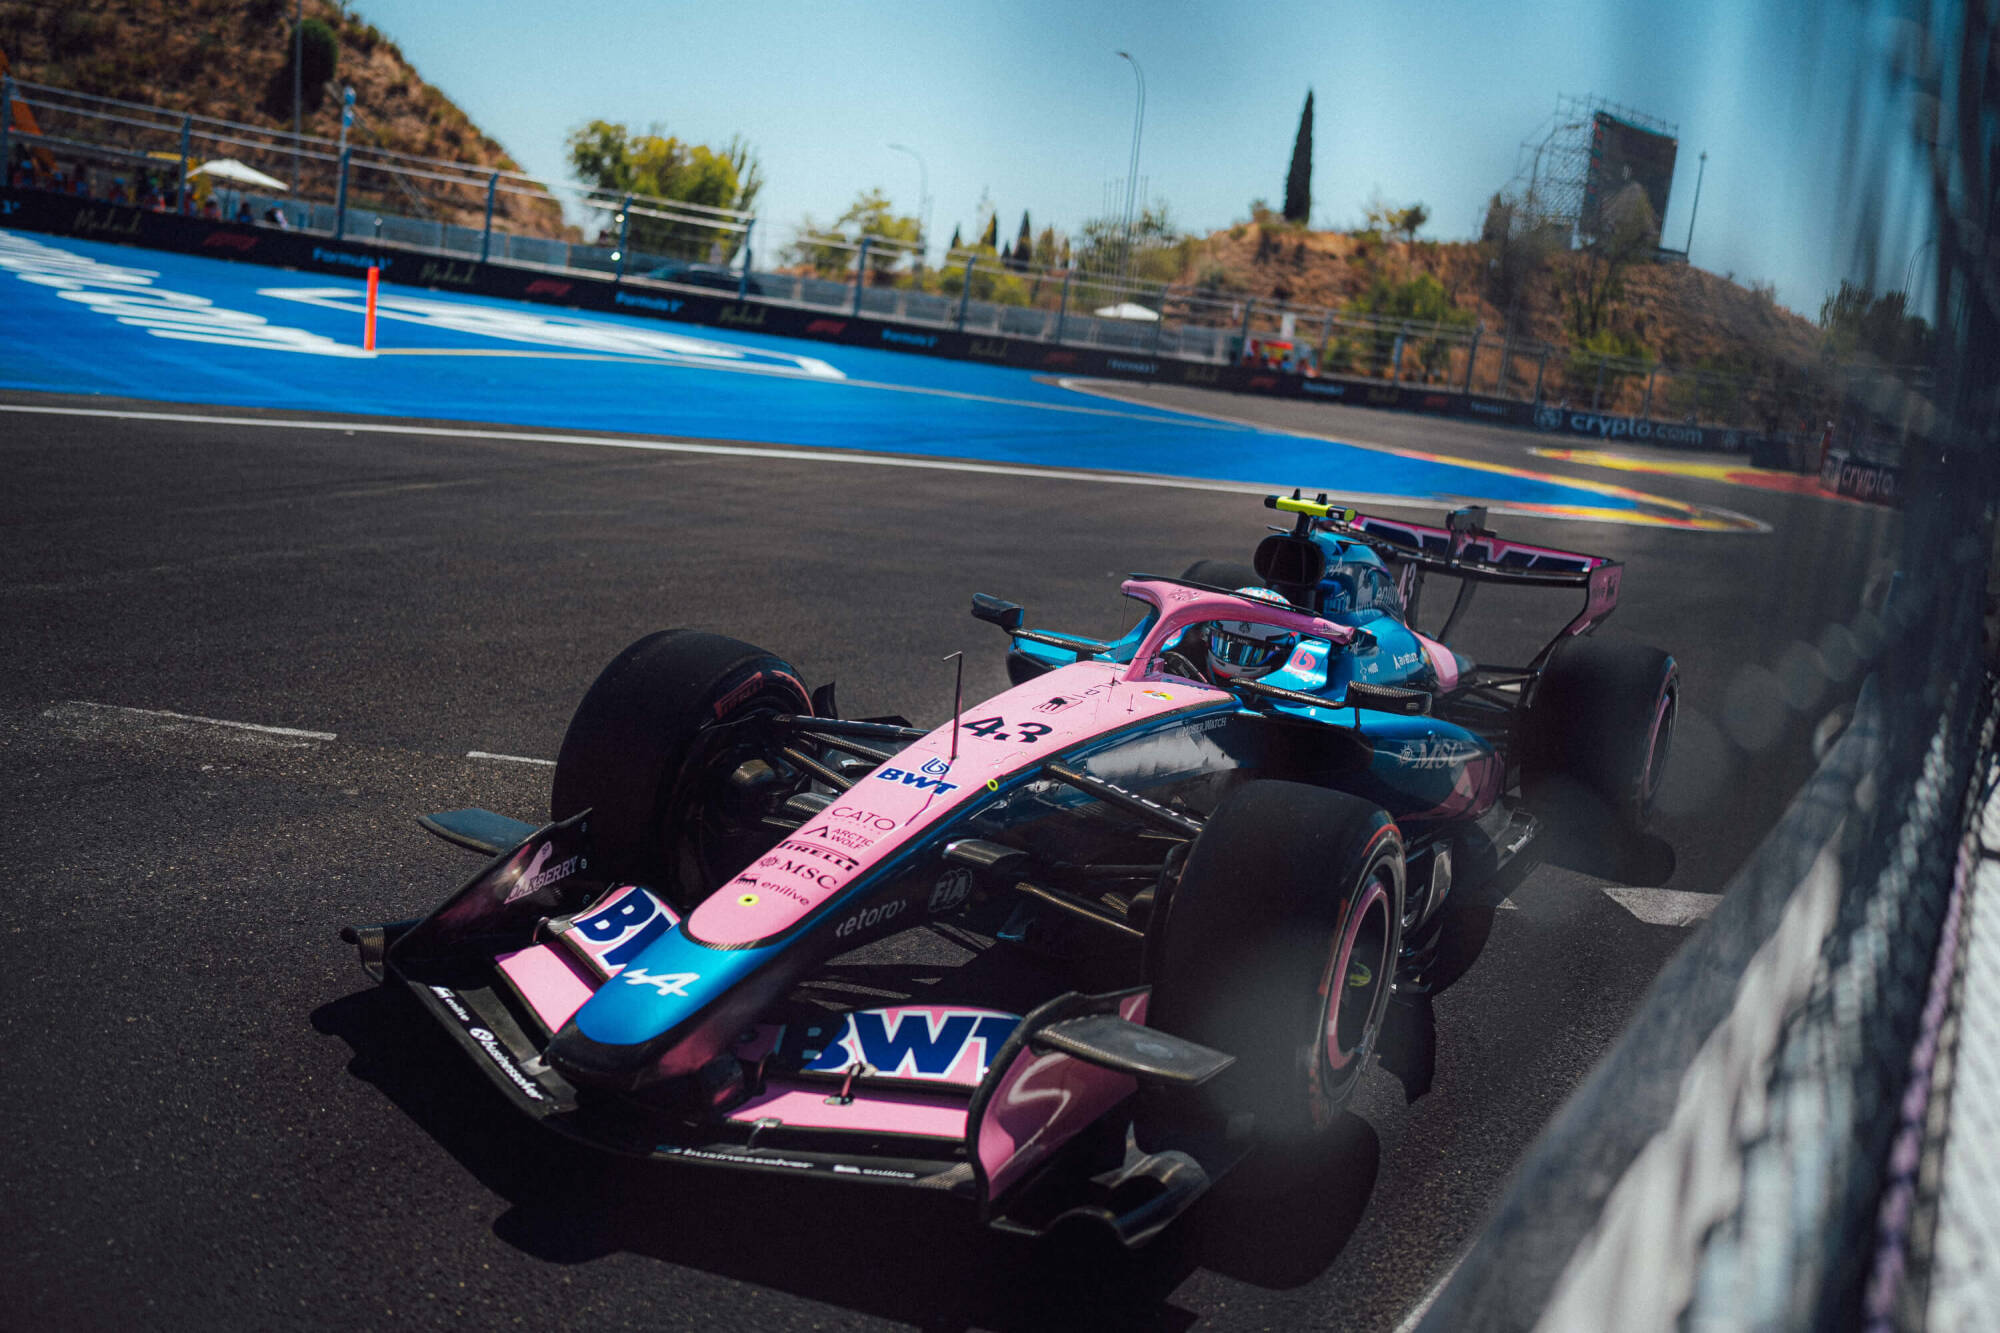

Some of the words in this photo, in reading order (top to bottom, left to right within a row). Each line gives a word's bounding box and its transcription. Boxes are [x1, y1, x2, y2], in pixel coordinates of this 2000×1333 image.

[960, 715, 1052, 744] 43
[1411, 740, 1463, 769] MSC
[876, 767, 959, 796] BWT
[832, 806, 896, 831] CATO
[830, 834, 864, 850] WOLF
[832, 828, 874, 847] ARCTIC
[776, 840, 859, 872] PIRELLI
[779, 860, 837, 890] MSC
[761, 880, 810, 906] enilive
[930, 874, 967, 909] FIA
